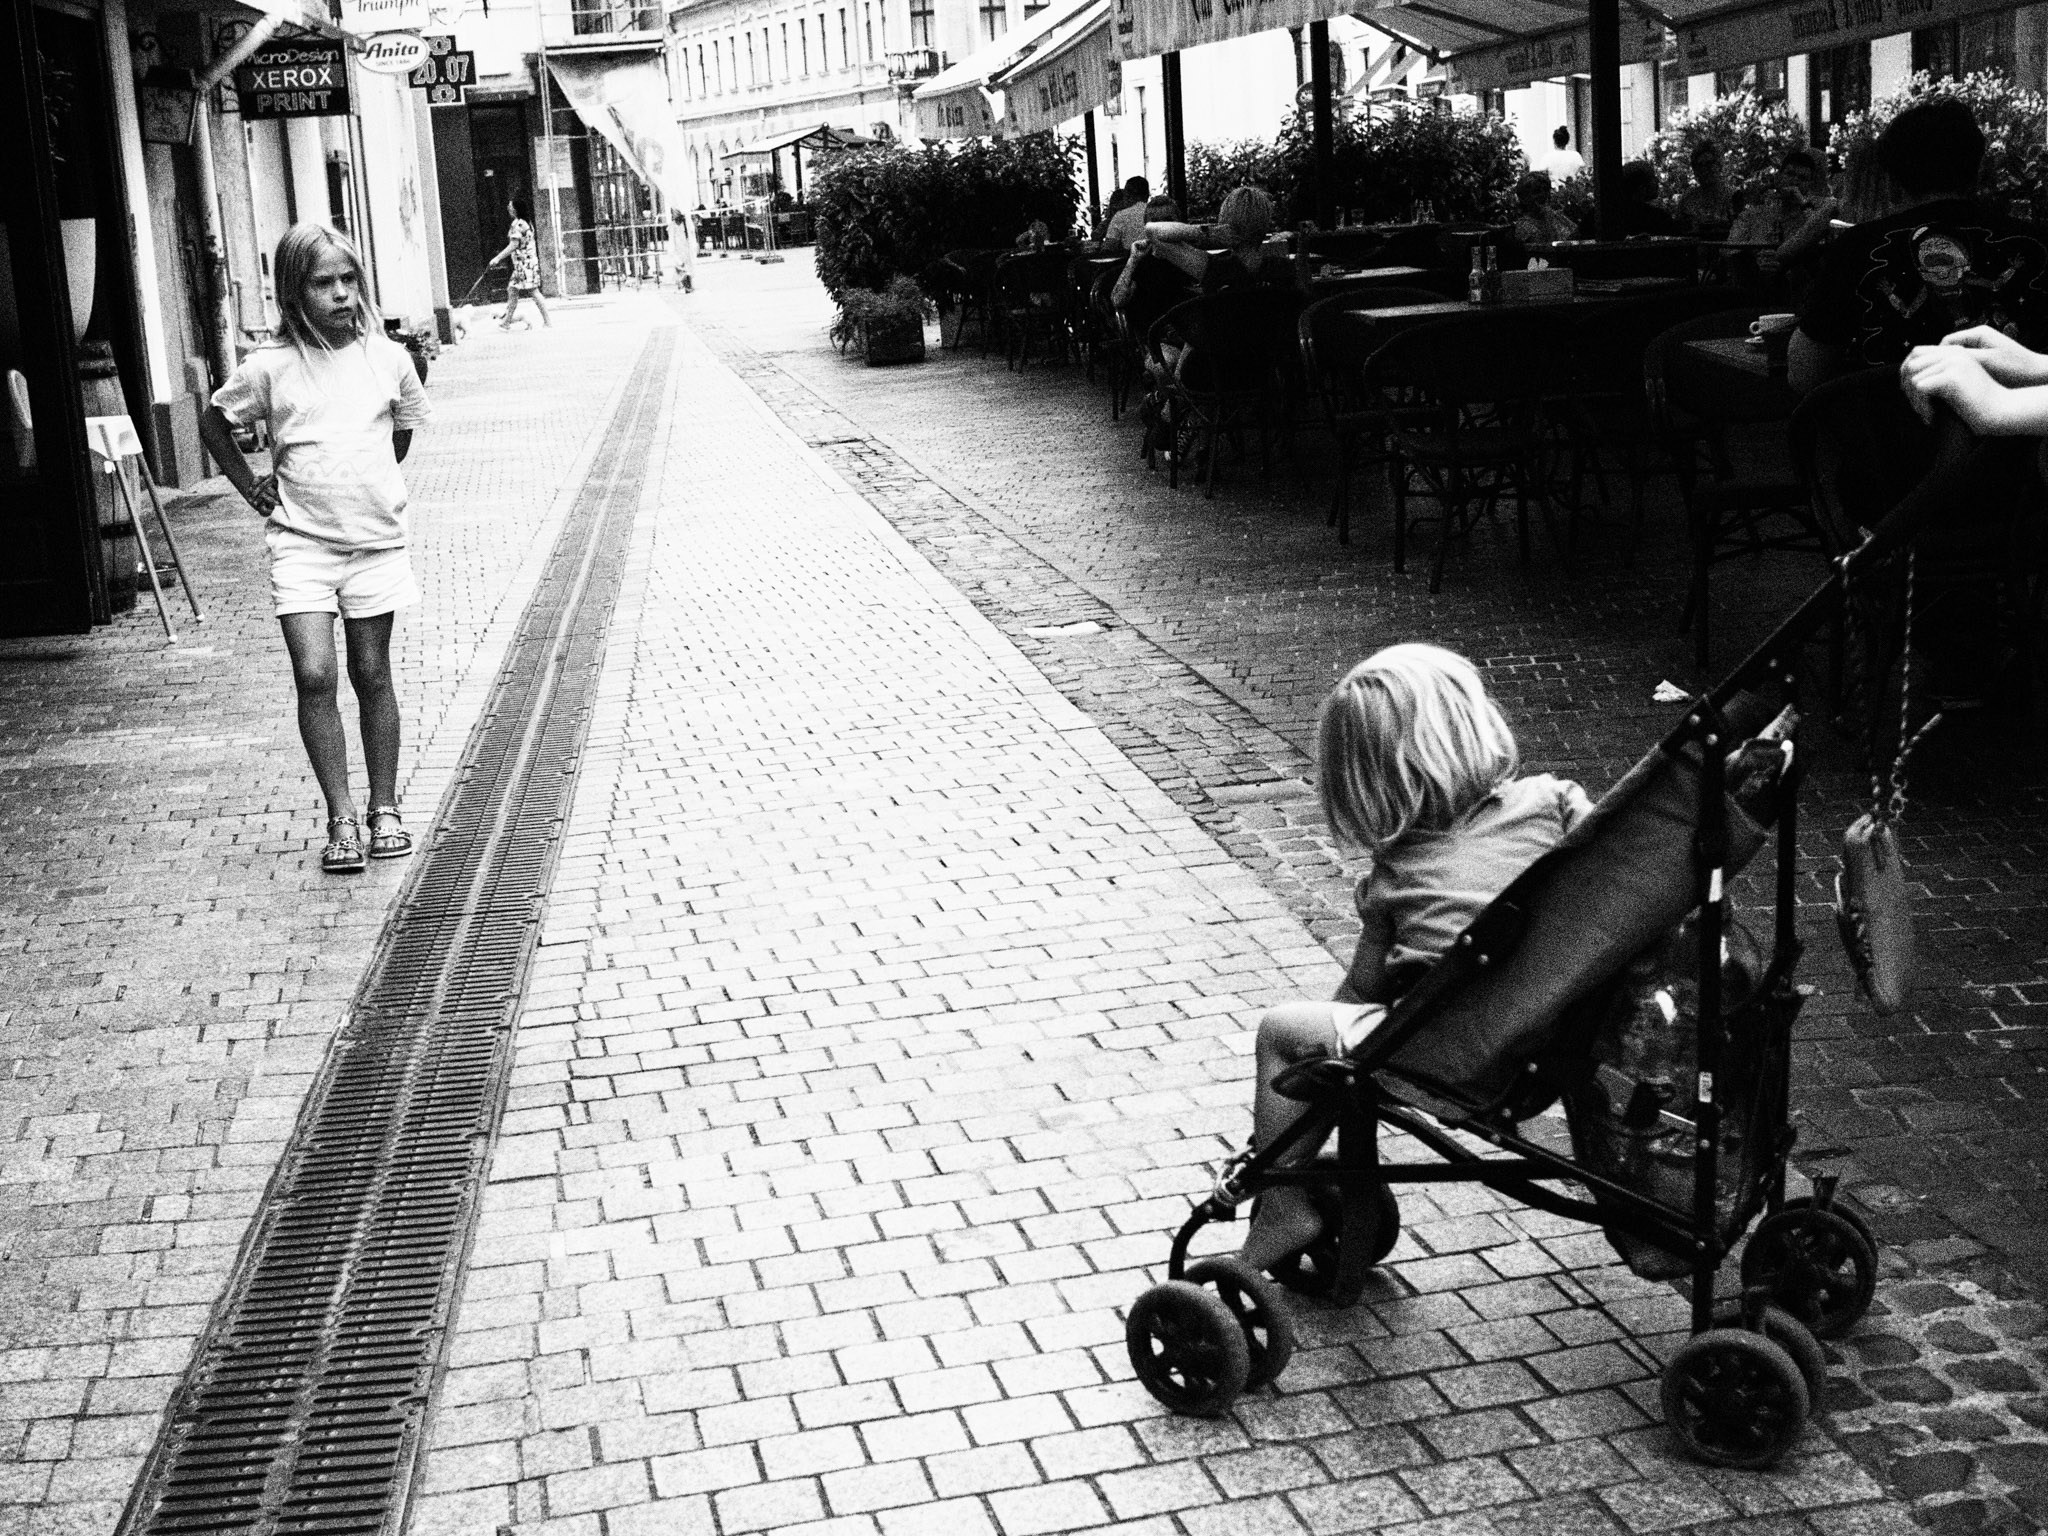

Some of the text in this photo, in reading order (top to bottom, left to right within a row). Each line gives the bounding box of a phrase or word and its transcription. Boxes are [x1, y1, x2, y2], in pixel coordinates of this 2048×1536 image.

[363, 41, 419, 59] Anita
[252, 67, 332, 88] XEROX
[256, 90, 331, 112] PRINT
